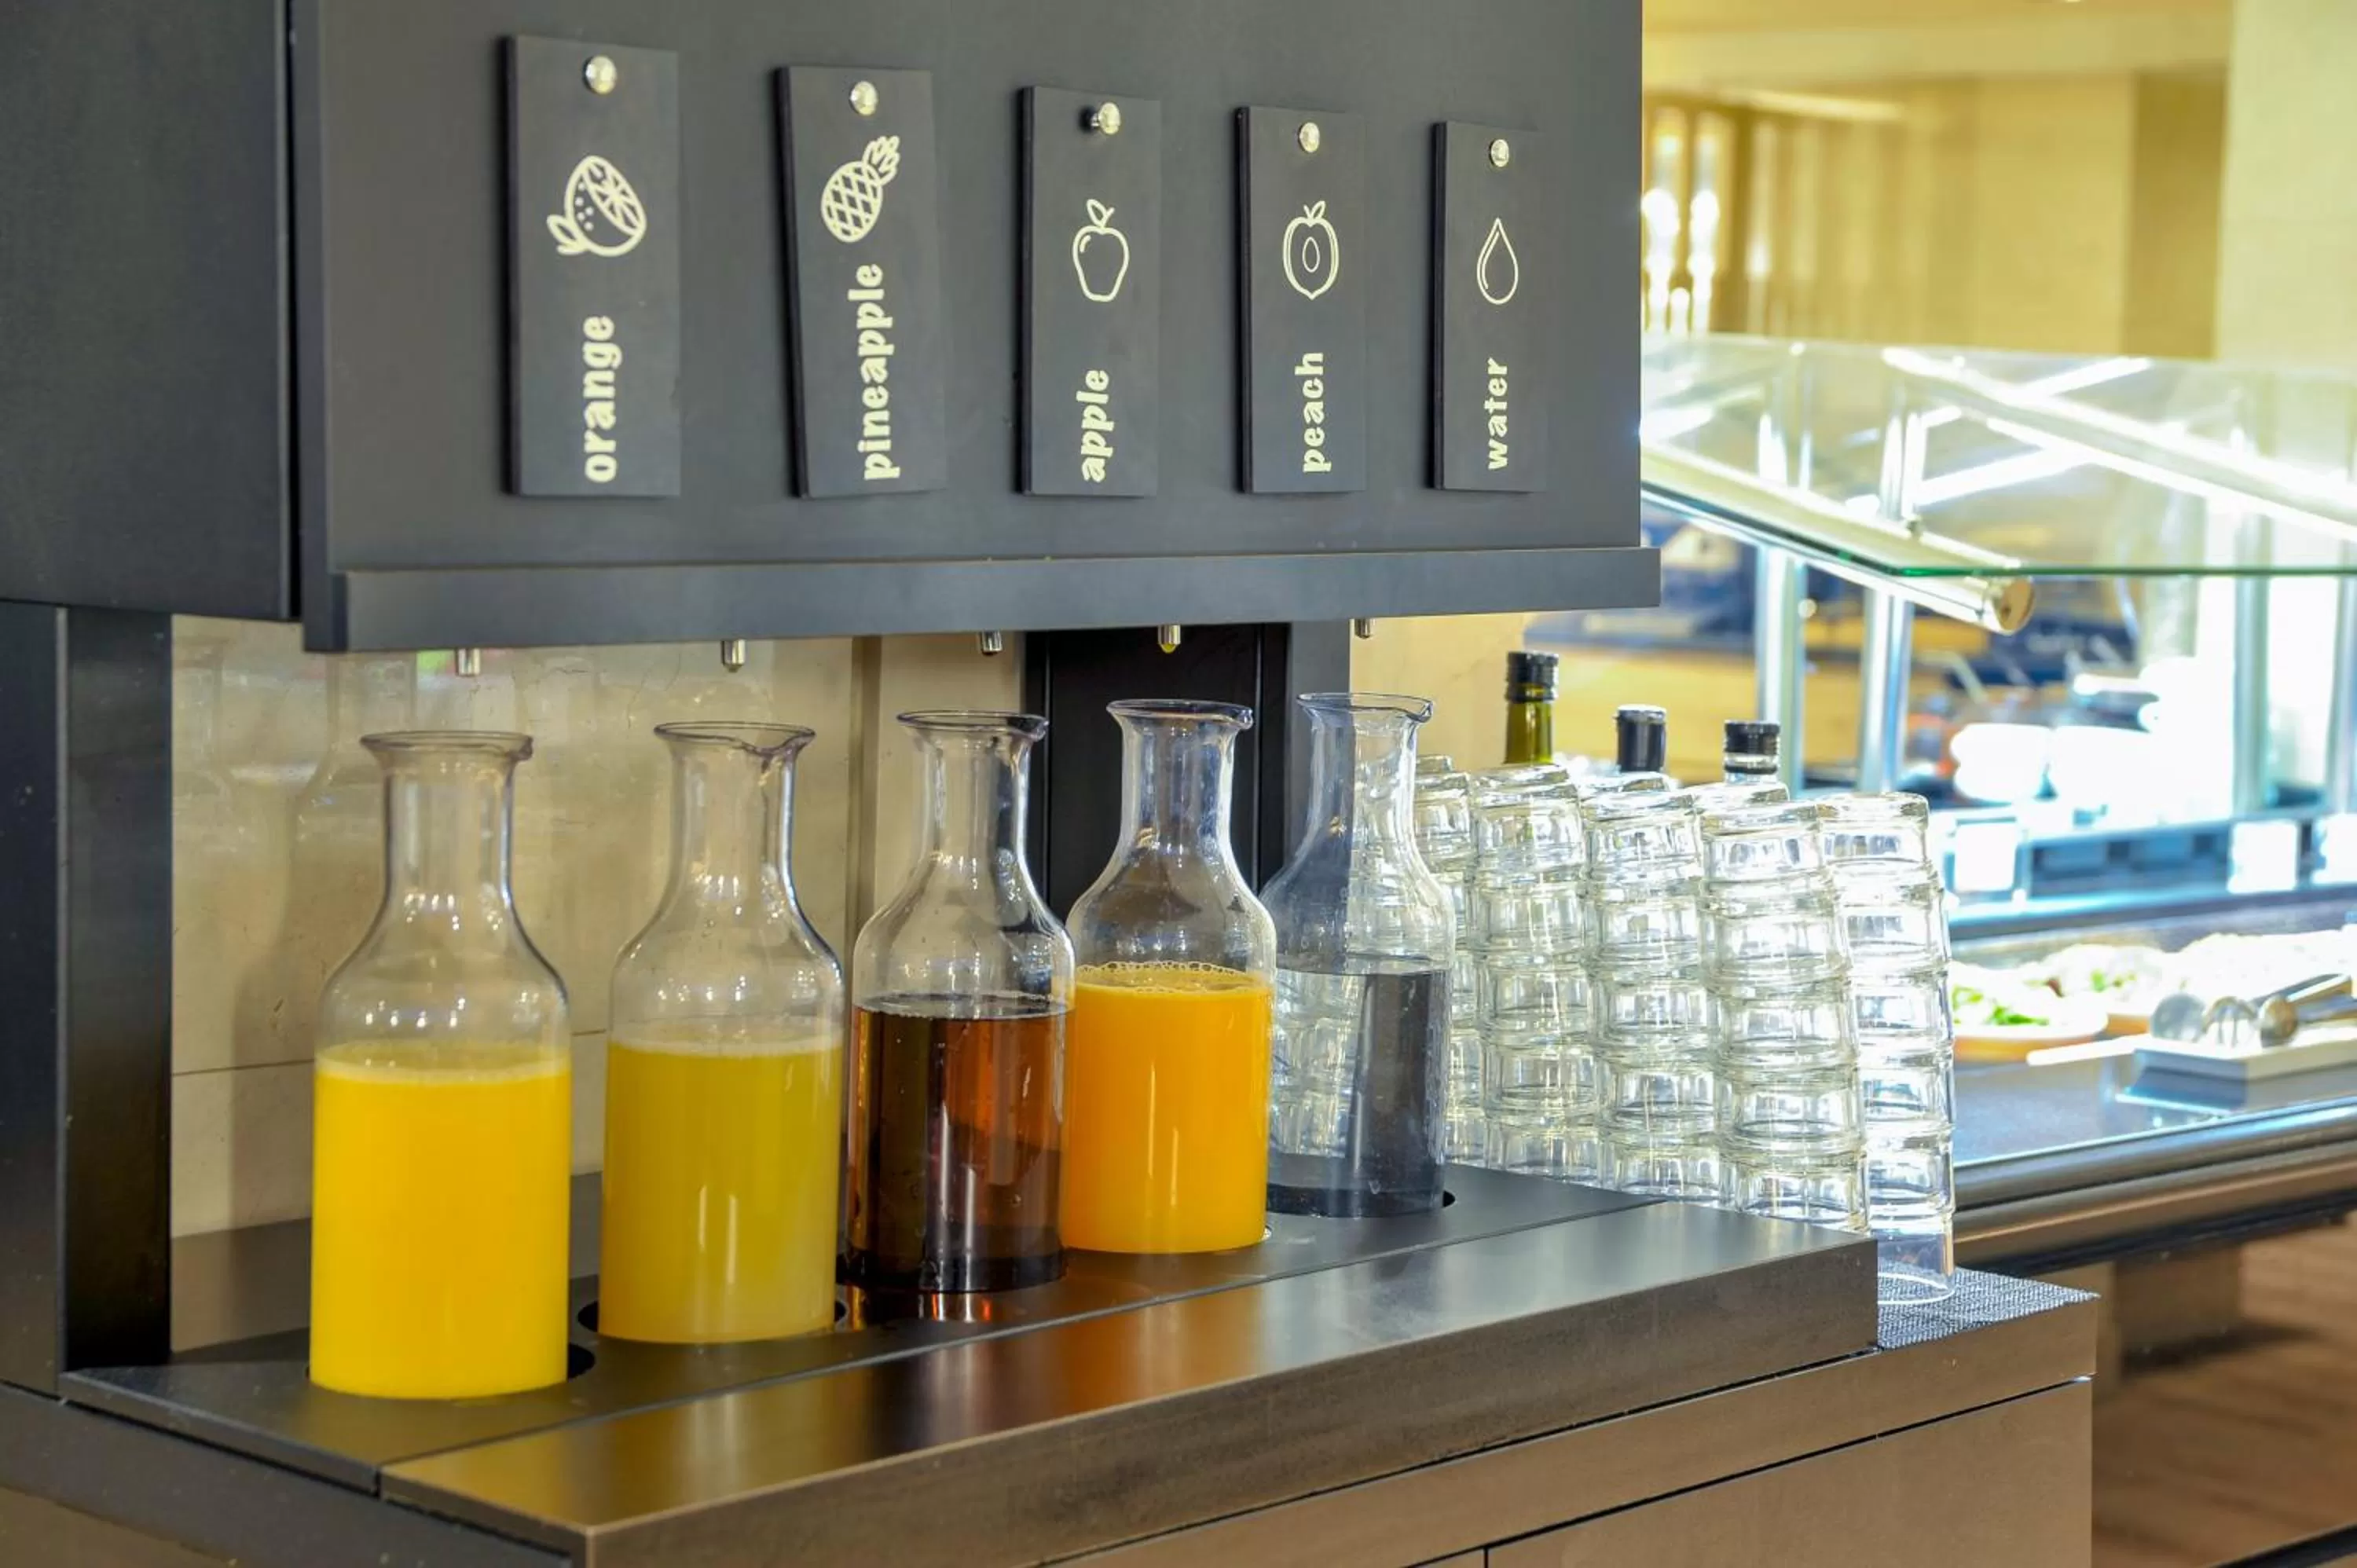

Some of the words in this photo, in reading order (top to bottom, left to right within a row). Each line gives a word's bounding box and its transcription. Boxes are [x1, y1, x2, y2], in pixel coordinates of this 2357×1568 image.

[581, 314, 623, 483] orange
[847, 263, 901, 481] pineapple
[1076, 368, 1116, 483] apple
[1294, 351, 1332, 474] peach
[1483, 357, 1508, 471] water
